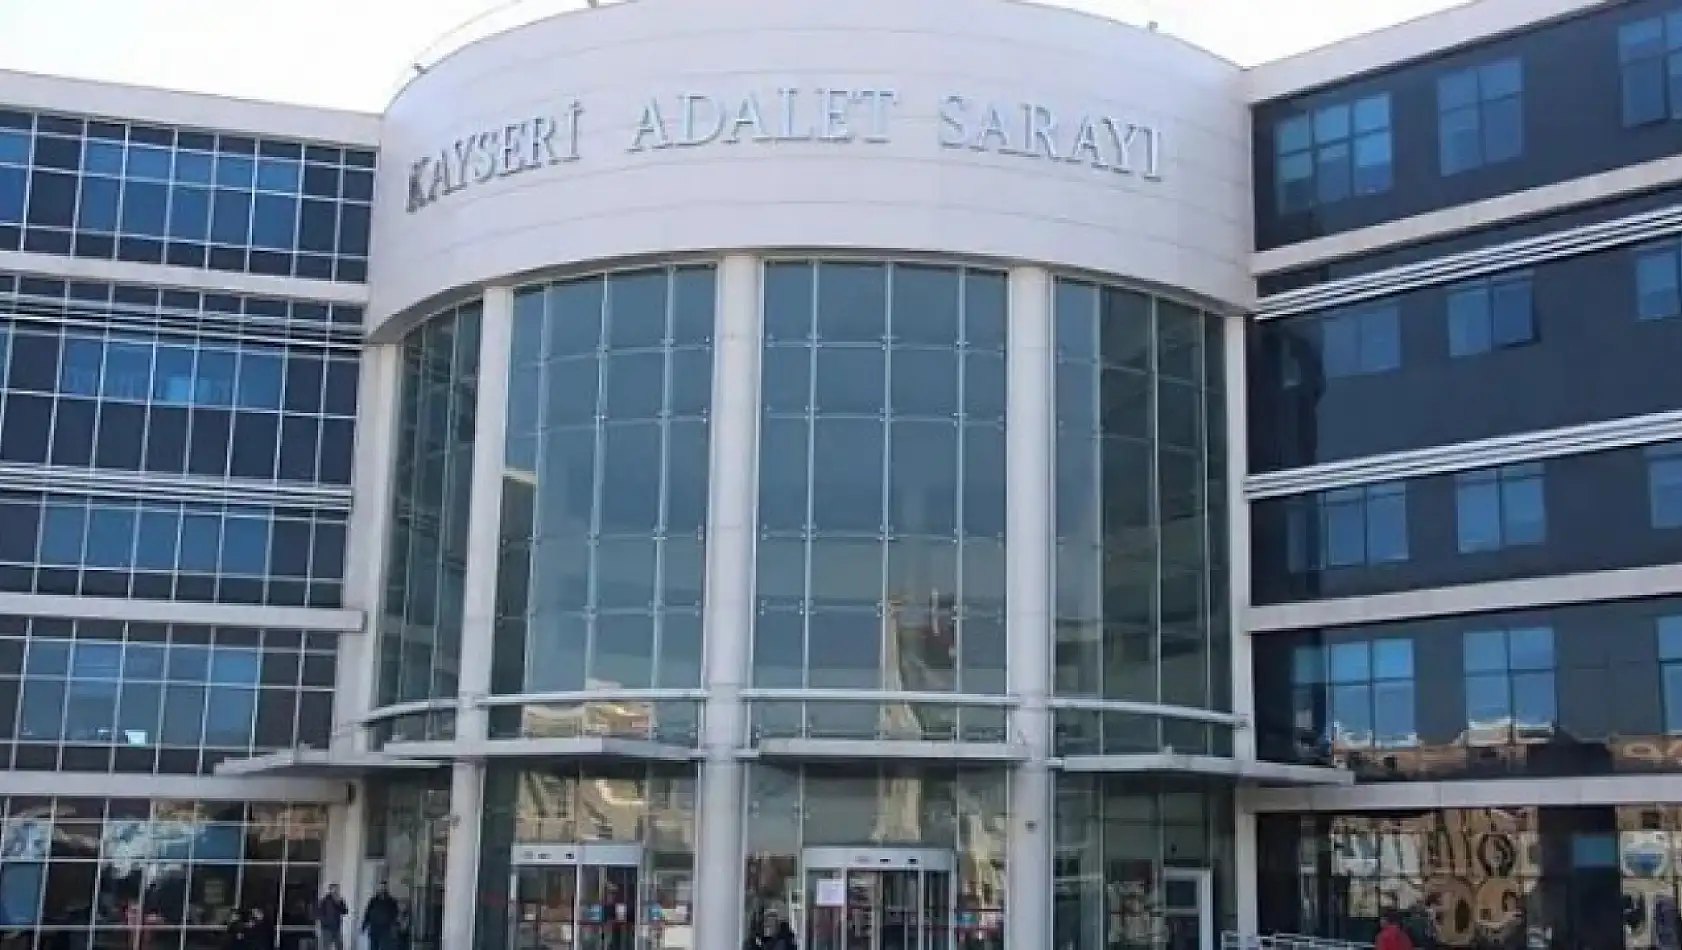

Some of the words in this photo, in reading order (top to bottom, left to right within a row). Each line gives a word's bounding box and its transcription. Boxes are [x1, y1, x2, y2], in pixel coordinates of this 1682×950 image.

[404, 96, 584, 214] KAYSERİ
[625, 87, 898, 152] ADALET
[939, 95, 1163, 182] SARAYI
